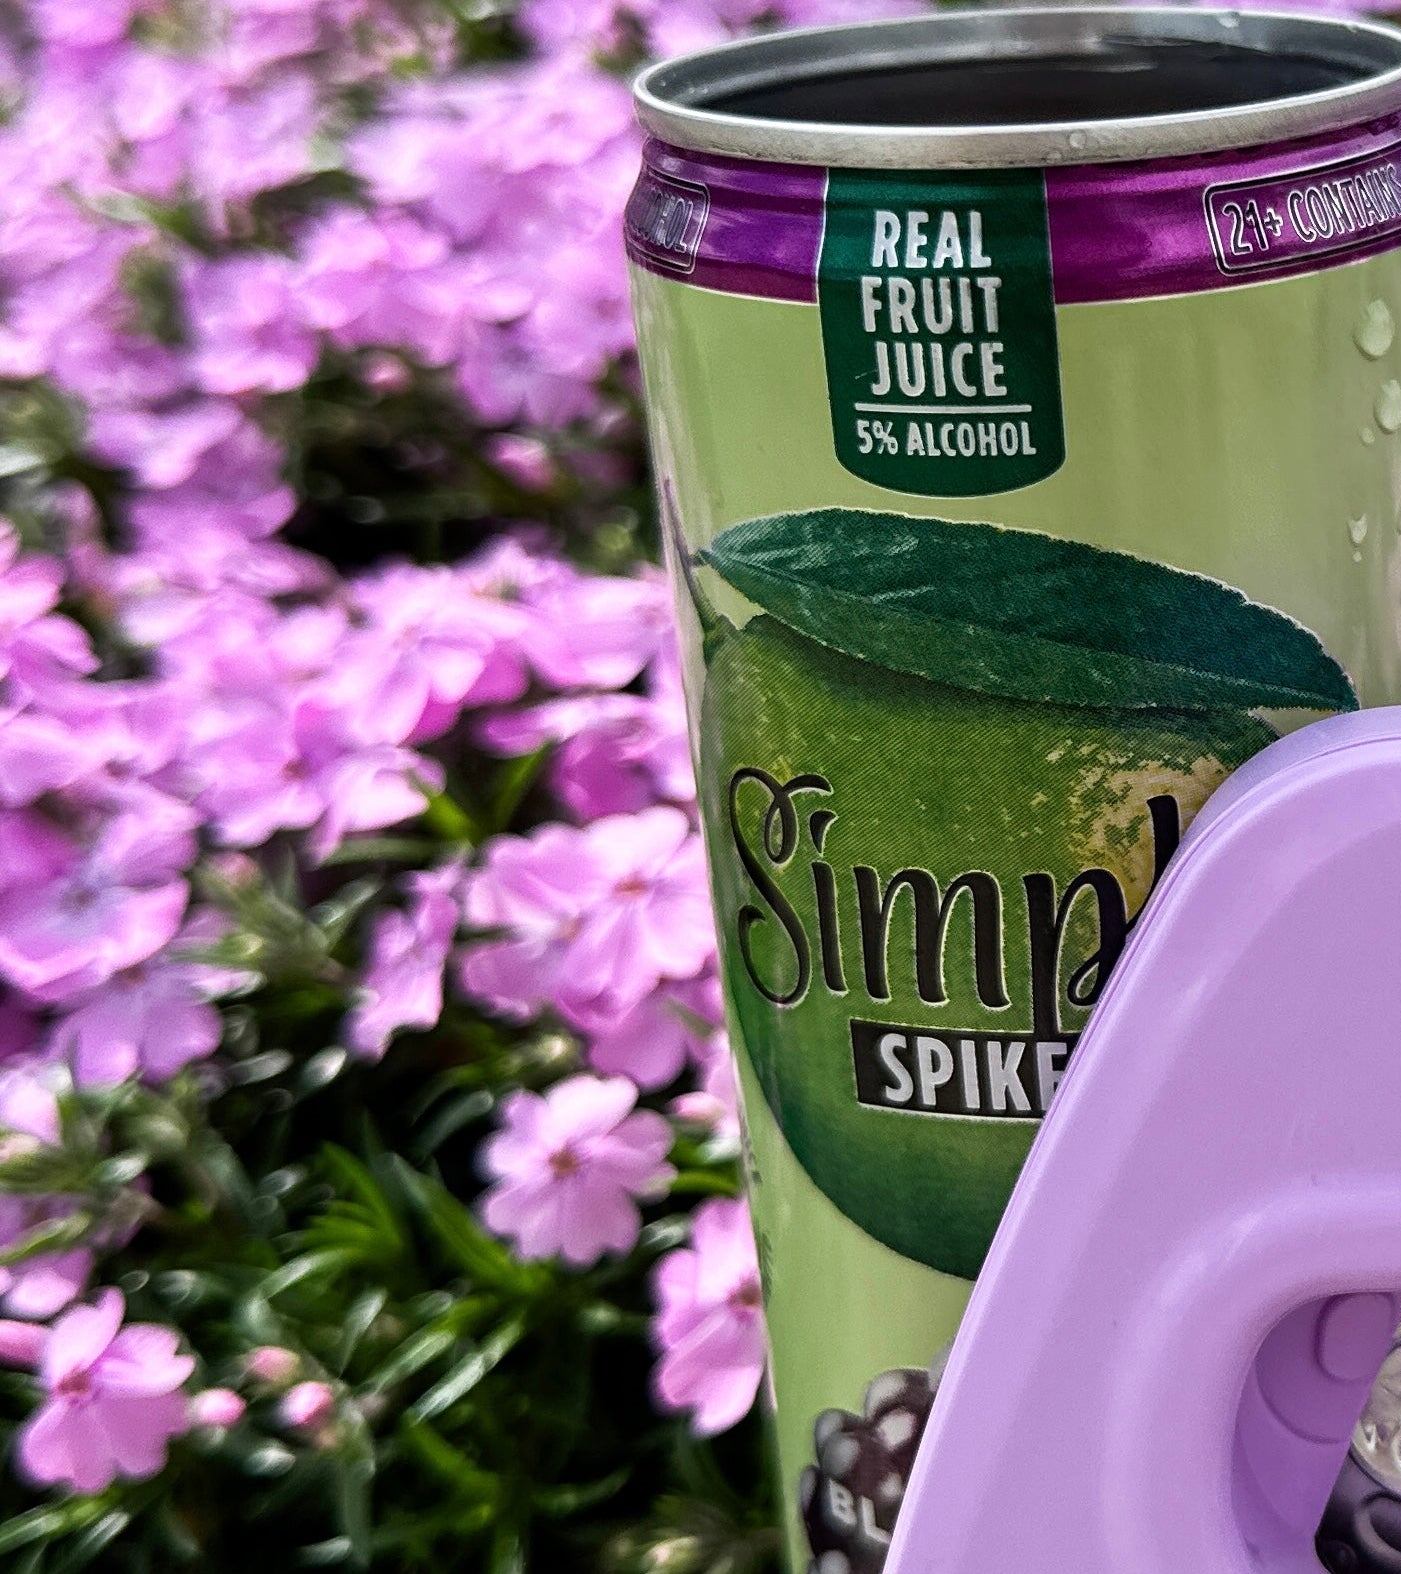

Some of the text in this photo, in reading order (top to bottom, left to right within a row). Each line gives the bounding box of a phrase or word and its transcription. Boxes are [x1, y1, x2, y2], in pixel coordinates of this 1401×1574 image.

[872, 210, 992, 269] REAL
[1222, 200, 1283, 256] 21+
[860, 276, 1002, 334] FRUIT
[871, 341, 1008, 398] JUICE
[855, 419, 1037, 457] 5% ALCOHOL
